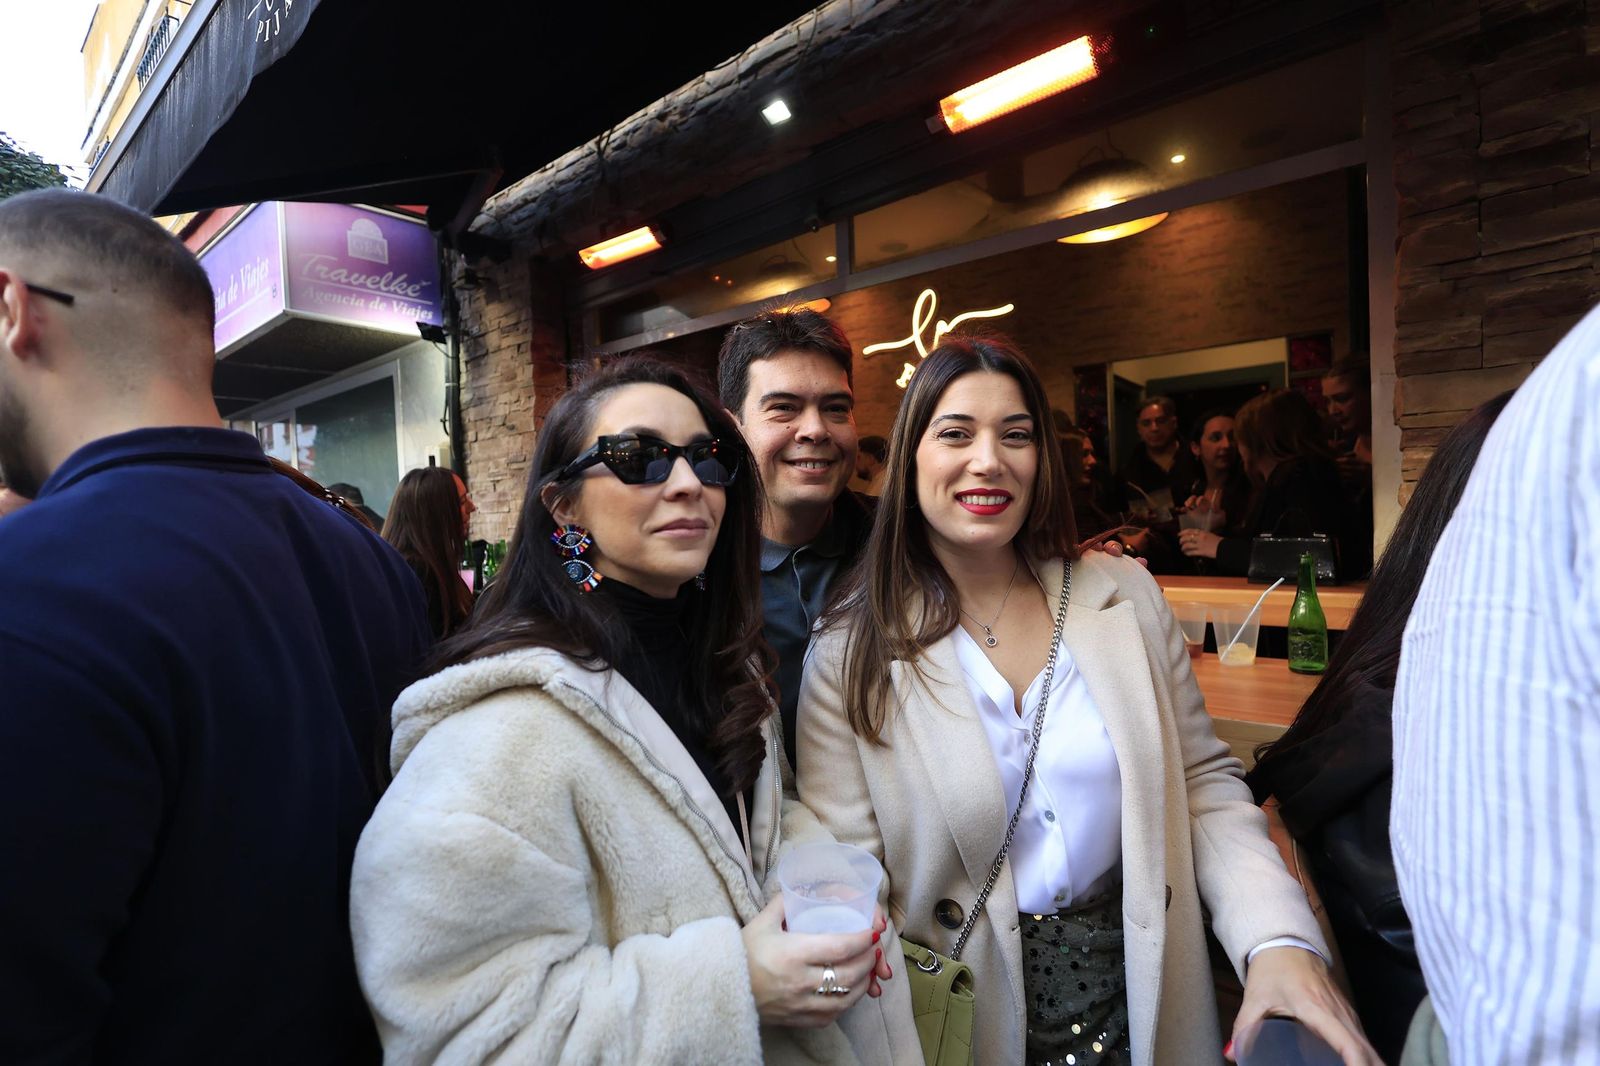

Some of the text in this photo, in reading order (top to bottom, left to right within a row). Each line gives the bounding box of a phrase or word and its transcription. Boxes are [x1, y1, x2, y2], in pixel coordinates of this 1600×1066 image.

[227, 273, 239, 305] de
[240, 255, 269, 296] Viajes
[302, 285, 365, 307] Agencia
[368, 296, 388, 311] de
[391, 299, 434, 320] Viajes
